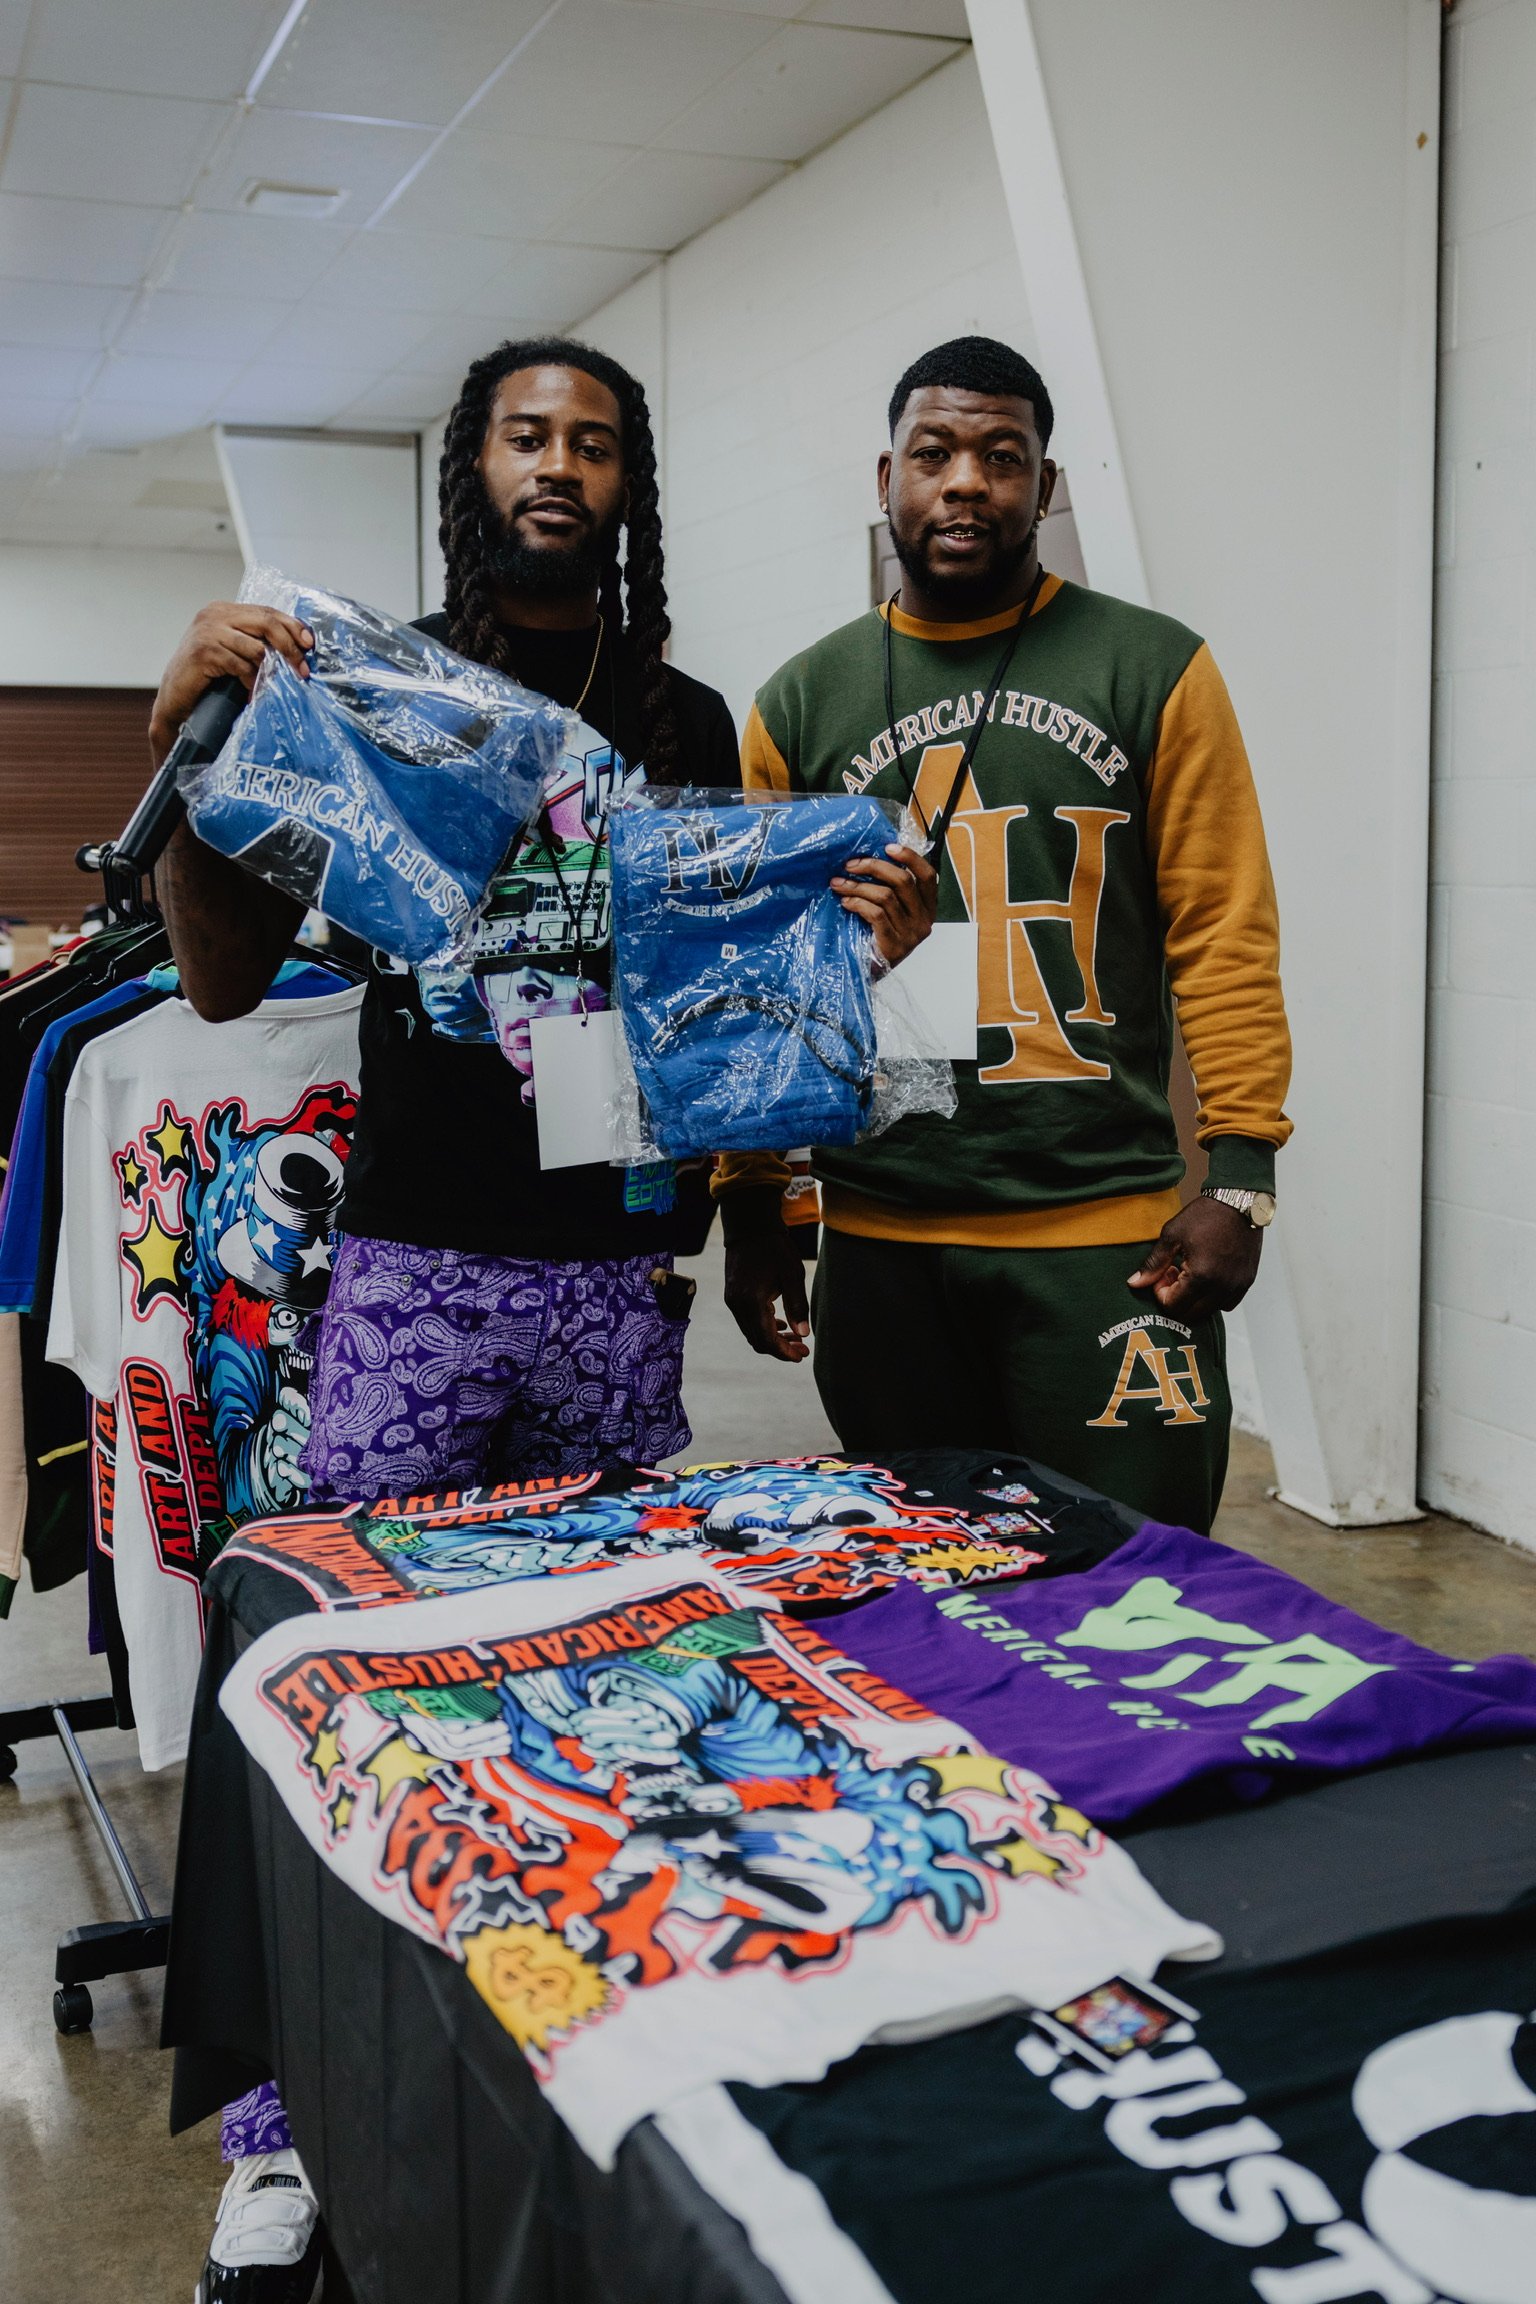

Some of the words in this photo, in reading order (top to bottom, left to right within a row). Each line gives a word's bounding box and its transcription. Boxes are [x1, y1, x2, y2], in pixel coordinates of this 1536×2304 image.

[1000, 690, 1129, 788] HUSTLE
[1097, 1314, 1155, 1349] AMERICAN
[1155, 1314, 1193, 1340] HUSTLE
[127, 1367, 180, 1461] AND
[149, 1474, 197, 1562] ART
[497, 1584, 735, 1675] AMERICAN
[273, 1650, 486, 1738] HUSTLE
